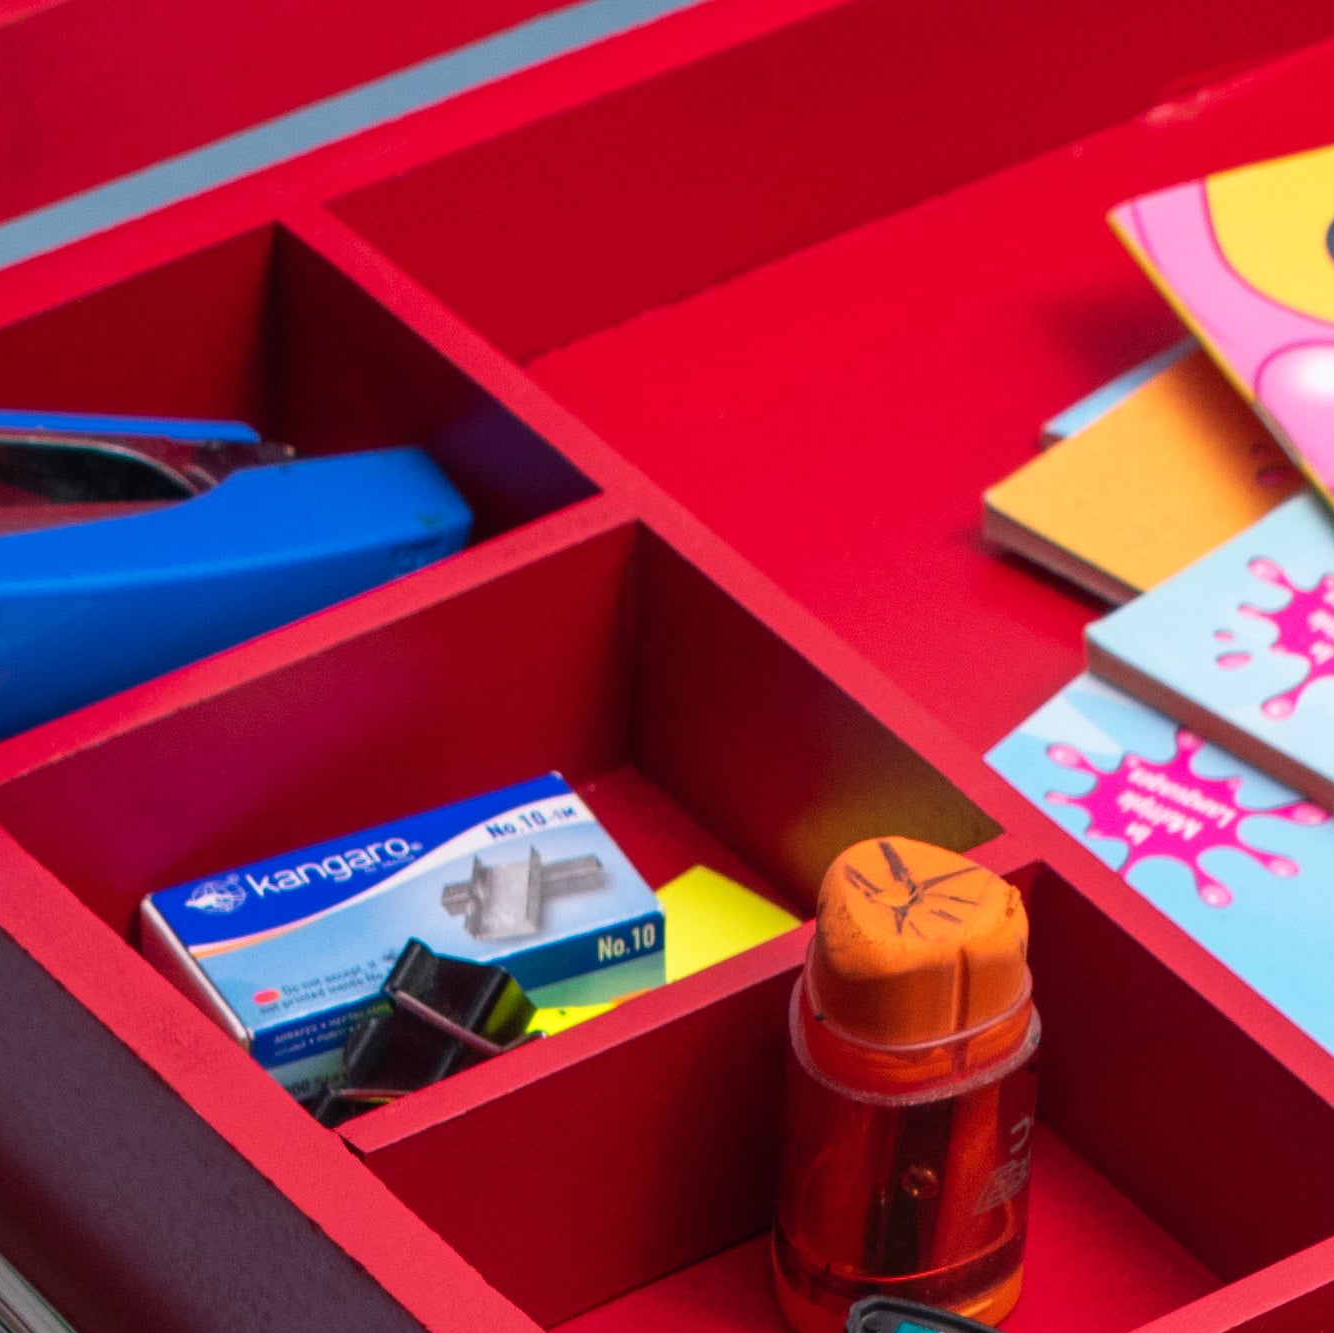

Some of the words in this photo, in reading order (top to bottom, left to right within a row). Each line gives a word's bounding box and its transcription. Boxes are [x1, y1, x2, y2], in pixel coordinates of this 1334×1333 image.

[1117, 790, 1203, 841] Multiple
[1127, 767, 1236, 829] Languages
[1125, 822, 1153, 846] In
[246, 837, 412, 898] kangaro
